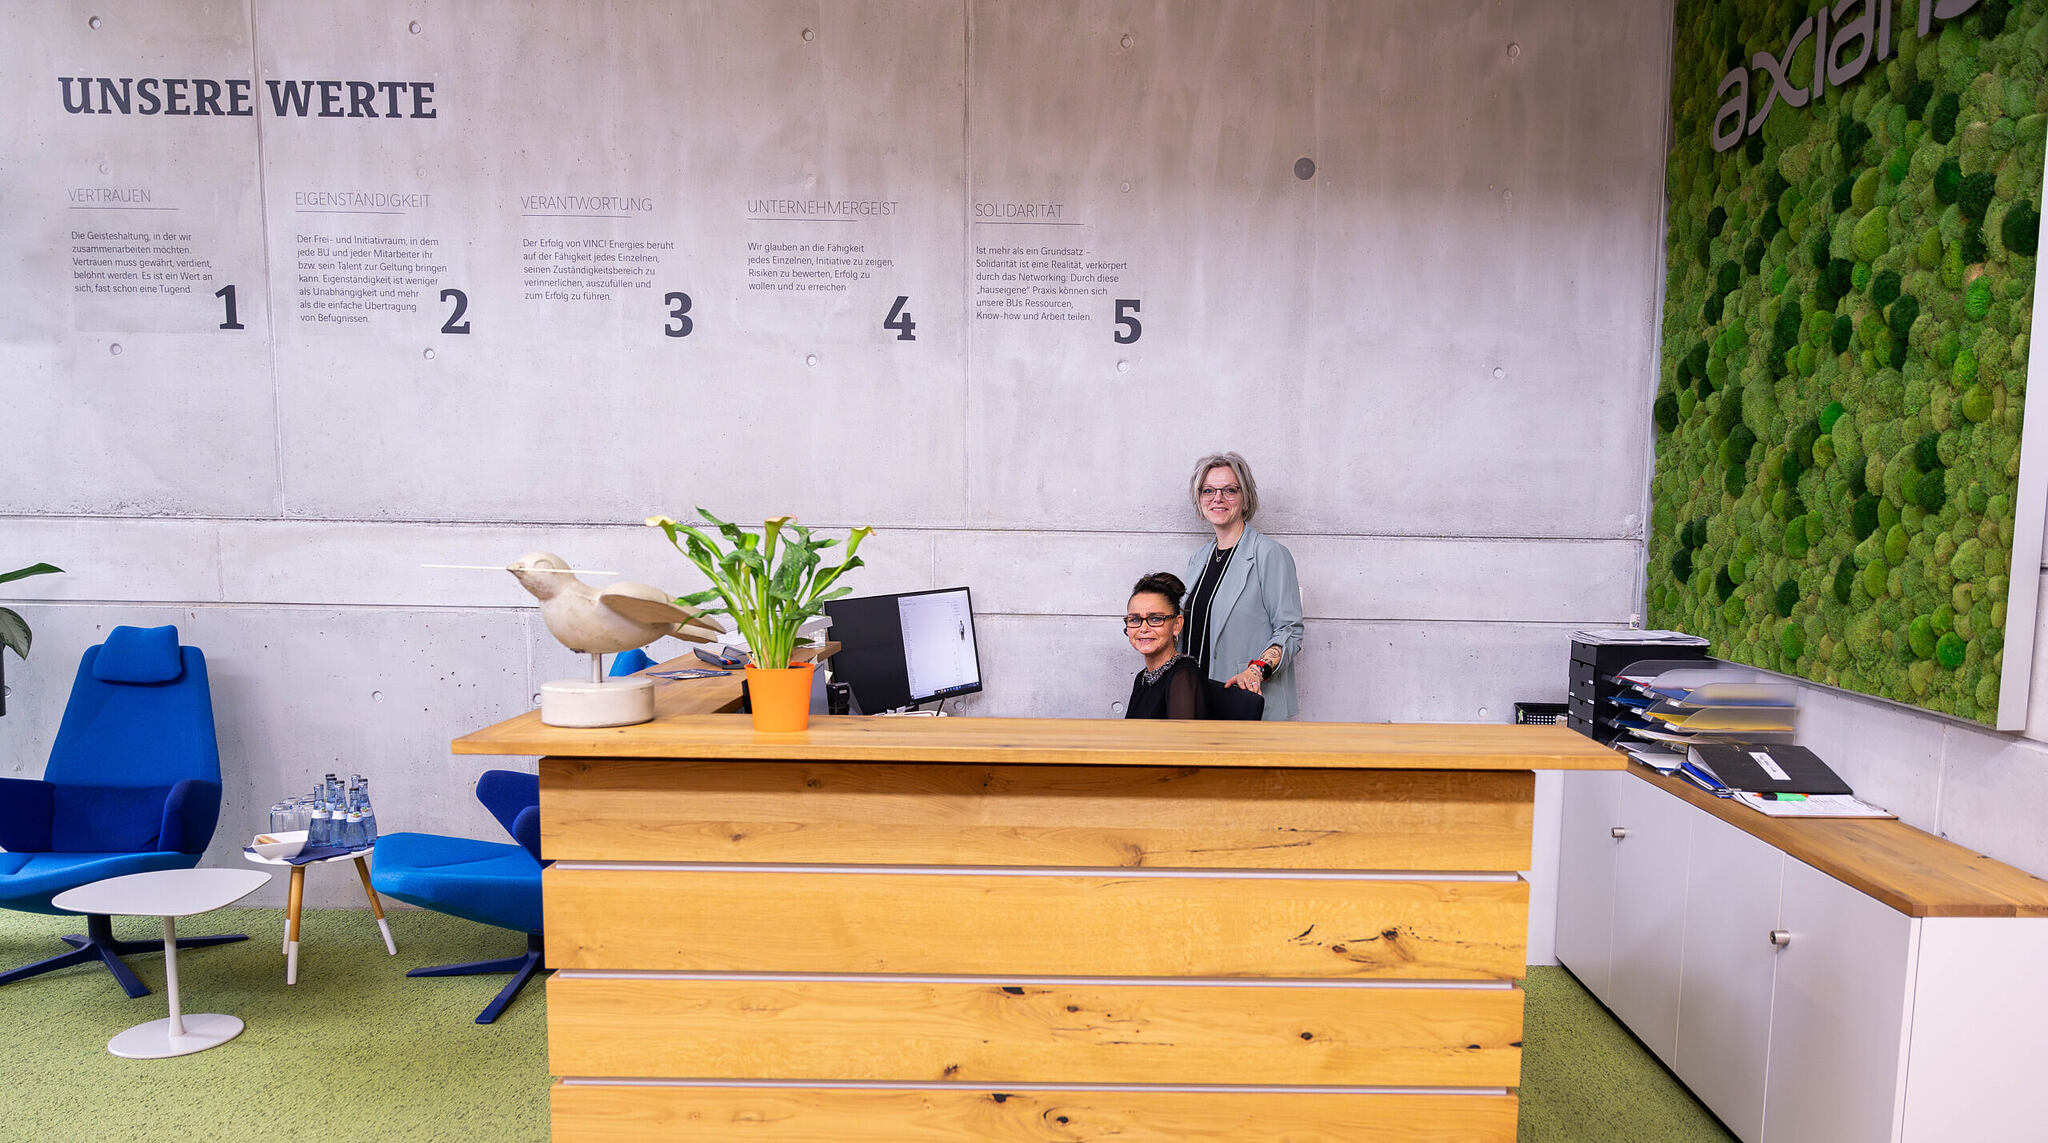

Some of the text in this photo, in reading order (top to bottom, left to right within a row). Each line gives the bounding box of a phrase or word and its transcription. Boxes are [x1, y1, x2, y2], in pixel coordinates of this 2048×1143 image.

[1712, 0, 1977, 152] axian
[58, 77, 437, 119] UNSERE WERTE
[68, 189, 151, 202] VERTRAUEN
[295, 190, 432, 208] EIGENSTÄNDIGKEIT
[521, 196, 652, 212] VERANTWORTUNG
[748, 200, 898, 215] UNTERNEHMERGEIST
[975, 202, 1064, 218] SOLIDARITÄT
[72, 231, 85, 240] Die
[153, 232, 160, 240] in
[163, 232, 176, 240] der
[179, 232, 191, 241] wir
[297, 235, 311, 243] Der
[336, 235, 351, 244] und
[354, 236, 408, 246] Initiativraum,
[410, 237, 417, 245] in
[420, 237, 438, 245] dem
[72, 245, 150, 254] zusammenarbeiten
[523, 239, 537, 247] Der
[540, 239, 563, 250] Erfolg
[583, 240, 606, 248] VINCI
[610, 240, 644, 251] Energies
[647, 241, 674, 249] beruht
[748, 243, 762, 251] Wir
[765, 243, 797, 254] glauben
[813, 243, 825, 252] die
[297, 248, 432, 260] jede BU und jeder Mitarbeiter ihr
[977, 246, 986, 255] Ist
[989, 246, 1010, 255] mehr
[1012, 247, 1023, 255] als
[1026, 247, 1038, 255] ein
[1041, 247, 1083, 256] Grundsatz
[73, 258, 112, 266] Vertrauen
[115, 259, 137, 267] muss
[177, 259, 212, 269] verdient,
[523, 252, 536, 260] auf
[539, 252, 552, 260] der
[593, 253, 616, 264] jedes
[618, 254, 660, 264] Einzelnen,
[748, 256, 770, 267] jedes
[773, 256, 814, 266] Einzelnen,
[816, 257, 851, 265] Initiative
[866, 258, 894, 269] zeigen,
[319, 261, 335, 270] sein
[338, 262, 362, 270] Talent
[380, 263, 413, 274] Geltung
[416, 264, 447, 274] bringen
[524, 265, 550, 274] seinen
[1020, 260, 1029, 269] ist
[1032, 260, 1049, 269] eine
[74, 271, 105, 279] belohnt
[142, 271, 151, 280] Es
[153, 271, 163, 280] ist
[166, 272, 178, 280] ein
[181, 272, 200, 280] Wert
[749, 269, 777, 278] Risiken
[792, 270, 832, 280] bewerten,
[835, 270, 858, 281] Erfolg
[976, 273, 999, 281] durch
[1002, 273, 1016, 281] das
[1071, 274, 1095, 282] Durch
[1097, 274, 1119, 283] diese
[393, 276, 403, 284] ist
[406, 277, 438, 287] weniger
[524, 279, 584, 289] verinnerlichen,
[635, 280, 651, 288] und
[749, 282, 775, 291] wollen
[778, 282, 793, 291] und
[75, 284, 93, 294] sich,
[95, 284, 110, 292] fast
[113, 284, 137, 293] schon
[140, 284, 157, 293] eine
[300, 287, 311, 296] als
[380, 288, 395, 297] und
[398, 289, 419, 297] mehr
[1033, 286, 1056, 295] Praxis
[1059, 287, 1088, 295] können
[1091, 287, 1107, 295] sich
[545, 292, 568, 303] Erfolg
[215, 285, 244, 330] 1
[300, 300, 311, 309] als
[313, 300, 325, 309] die
[328, 301, 362, 309] einfache
[1006, 299, 1022, 308] BUs
[1025, 300, 1073, 310] Ressourcen,
[440, 289, 470, 334] 2
[664, 292, 693, 337] 3
[977, 312, 1021, 320] Know-how
[1024, 312, 1039, 321] und
[1041, 312, 1065, 321] Arbeit
[301, 314, 315, 322] von
[884, 296, 916, 341] 4
[1114, 299, 1142, 344] 5
